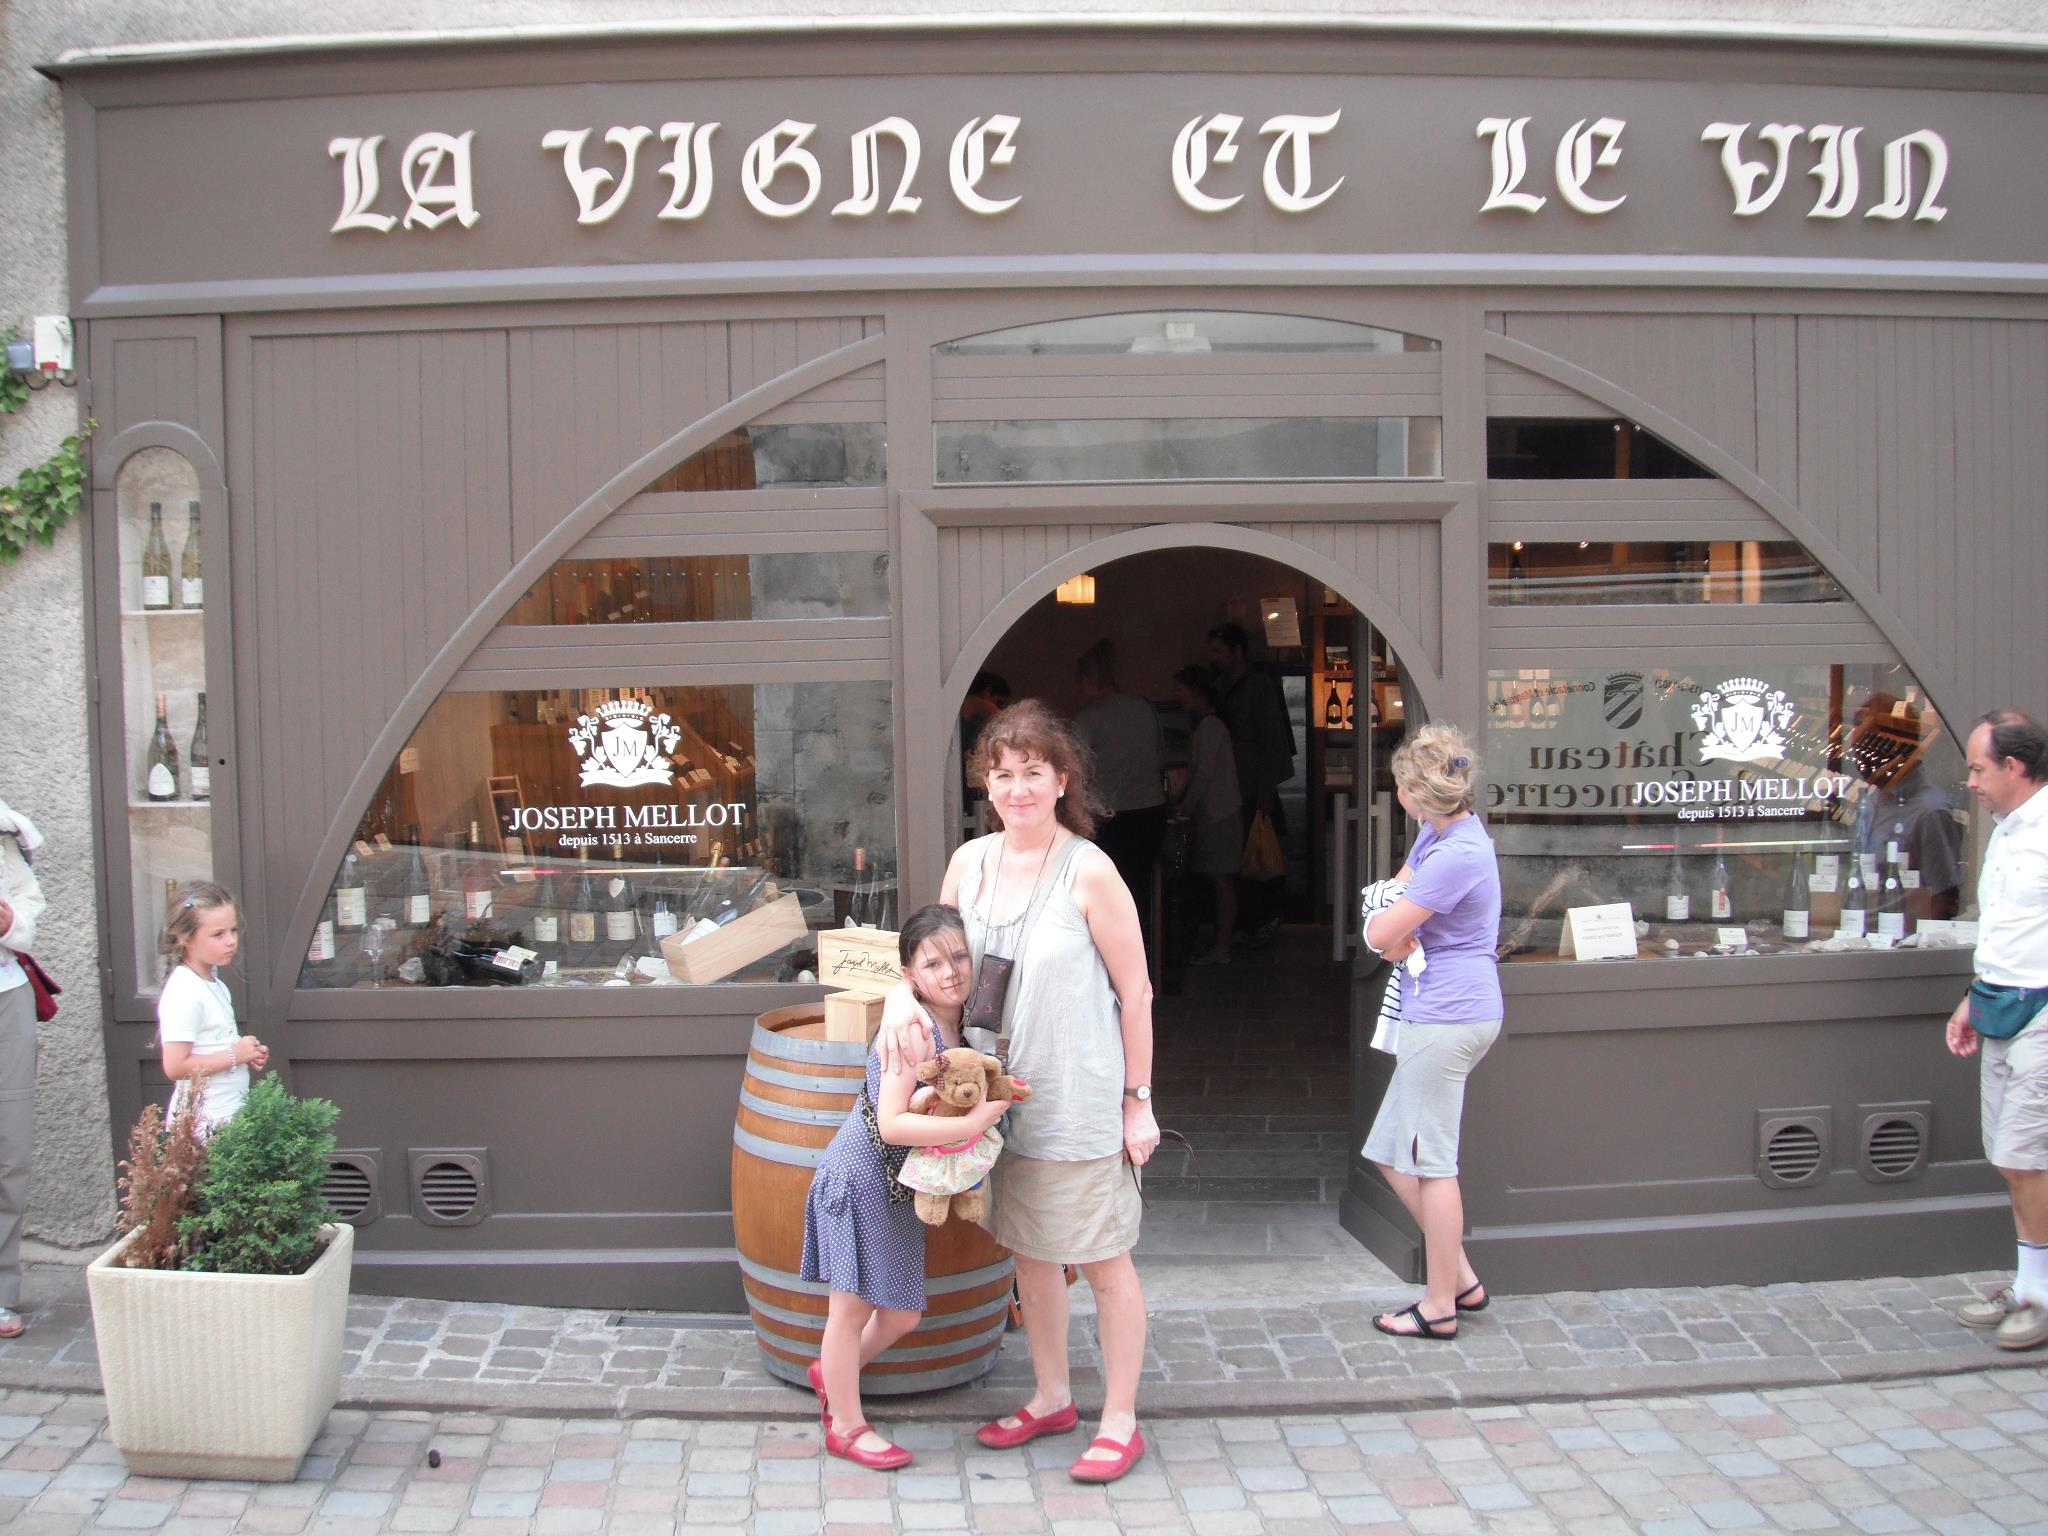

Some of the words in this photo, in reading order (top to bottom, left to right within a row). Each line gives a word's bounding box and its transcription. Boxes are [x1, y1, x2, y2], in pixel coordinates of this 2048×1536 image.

[329, 131, 480, 232] LA
[542, 114, 1022, 224] VIGNE
[1172, 108, 1345, 213] ET
[1476, 117, 1627, 214] LE
[1701, 123, 1950, 222] VIN
[1633, 779, 1733, 804] JOSEPH
[1739, 776, 1852, 802] MELLOT
[509, 806, 616, 830] JOSEPH
[623, 803, 746, 828] MELLOT
[1677, 807, 1715, 822] depuis
[1718, 805, 1744, 818] 1513
[1747, 805, 1755, 817] à
[1757, 804, 1805, 817] Sancerre
[558, 833, 598, 849] depuis
[603, 832, 631, 845] 1513
[634, 832, 642, 845] à
[645, 832, 698, 845] Sancerre
